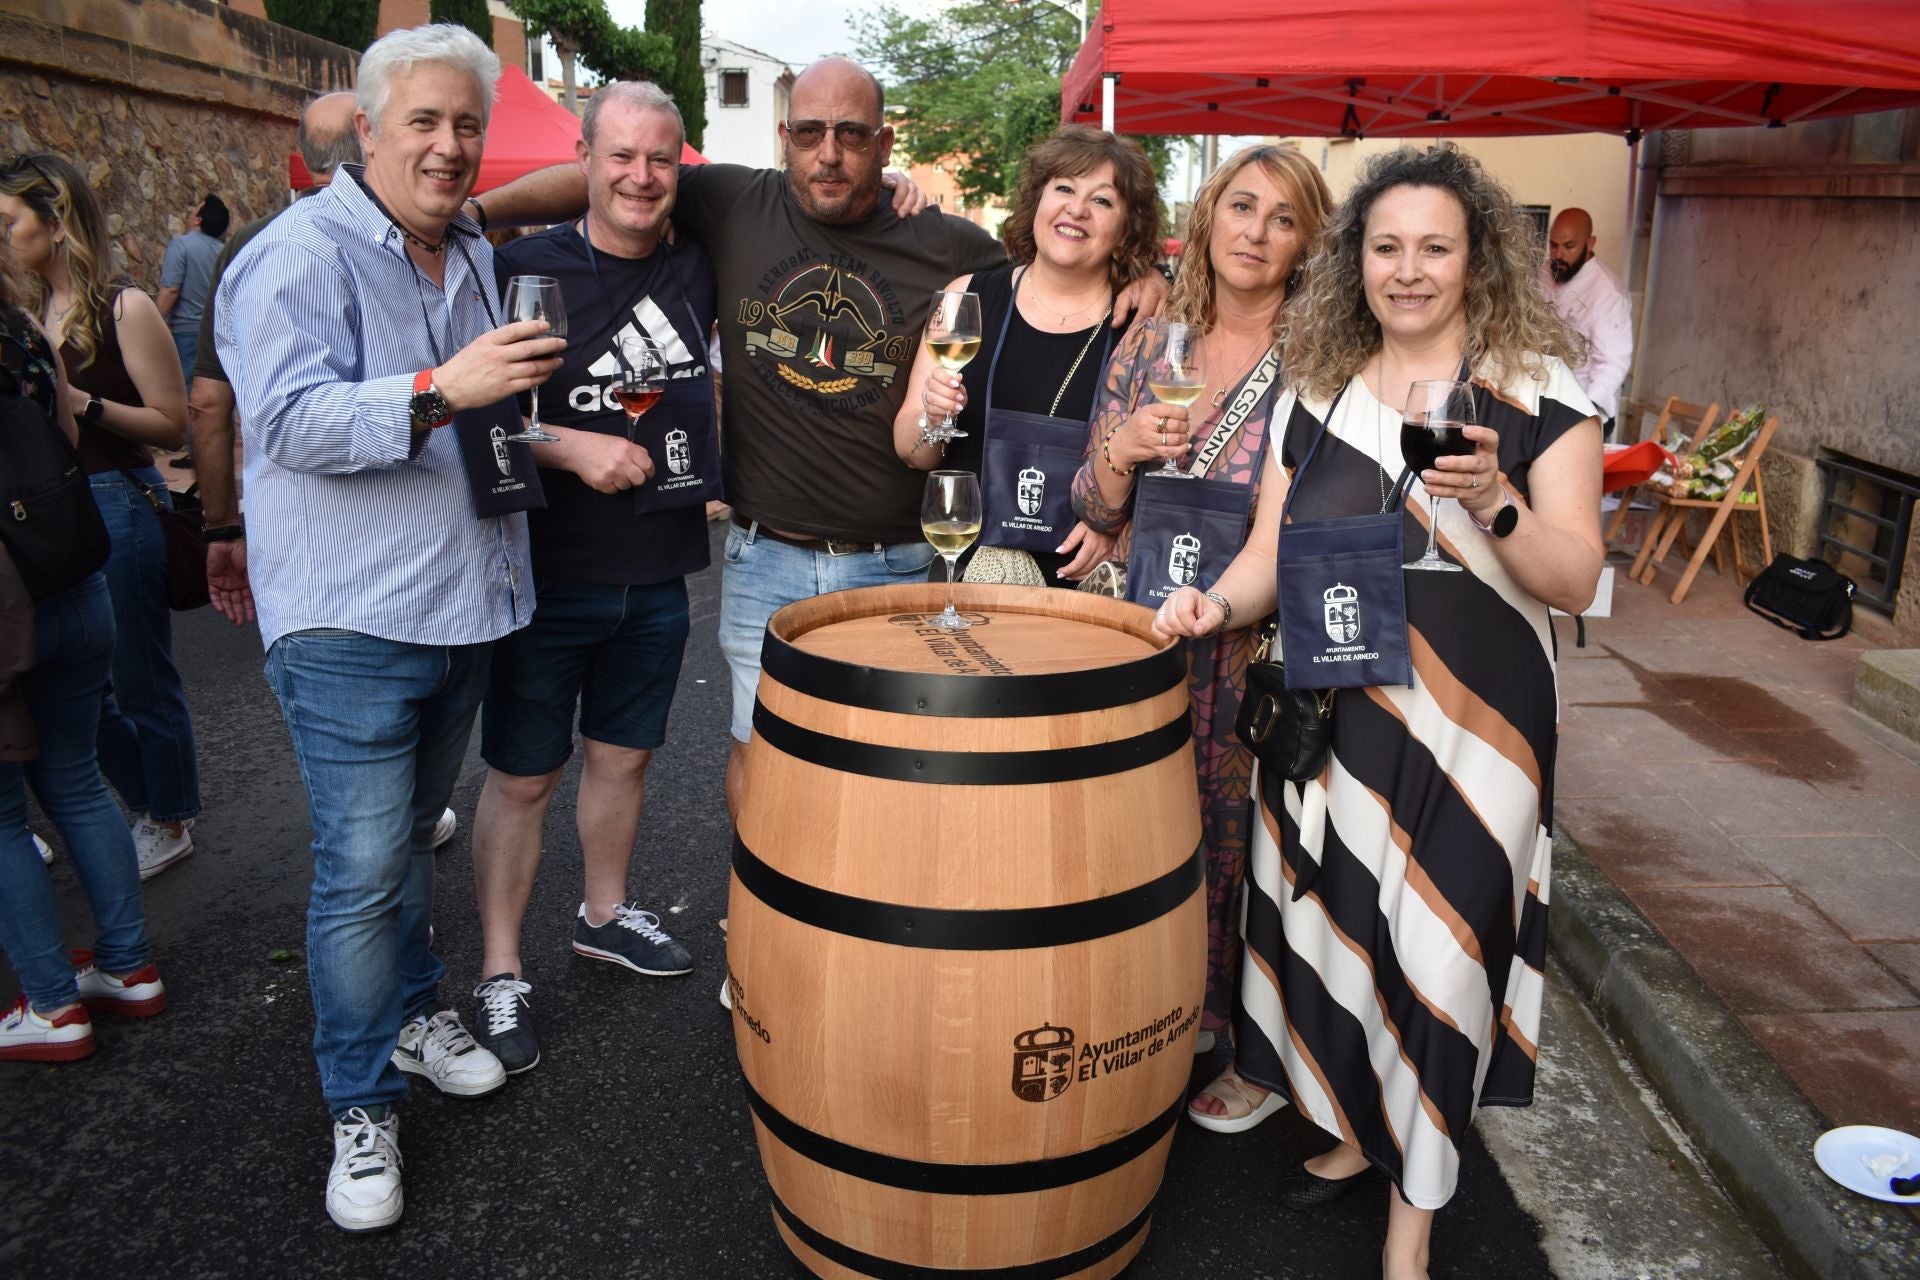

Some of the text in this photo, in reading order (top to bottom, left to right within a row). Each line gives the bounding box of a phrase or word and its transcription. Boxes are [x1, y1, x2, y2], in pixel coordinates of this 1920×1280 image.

[828, 253, 867, 275] TEAM
[737, 297, 765, 327] 19
[884, 335, 913, 361] 61
[1198, 388, 1257, 470] CSDMNT
[664, 482, 680, 491] VILLAR
[1001, 520, 1008, 528] EL
[1008, 521, 1026, 529] VILLAR
[1033, 524, 1053, 533] ARNEDO
[1149, 589, 1171, 598] EL VILL
[1321, 655, 1342, 663] VILLAR
[1342, 653, 1352, 662] DE
[1352, 652, 1379, 661] ARNEDO
[1325, 645, 1366, 654] AYUNTAMIENTO
[1078, 1006, 1183, 1062] Ayuntamiento
[1078, 1005, 1200, 1082] El Villar de Arnedo
